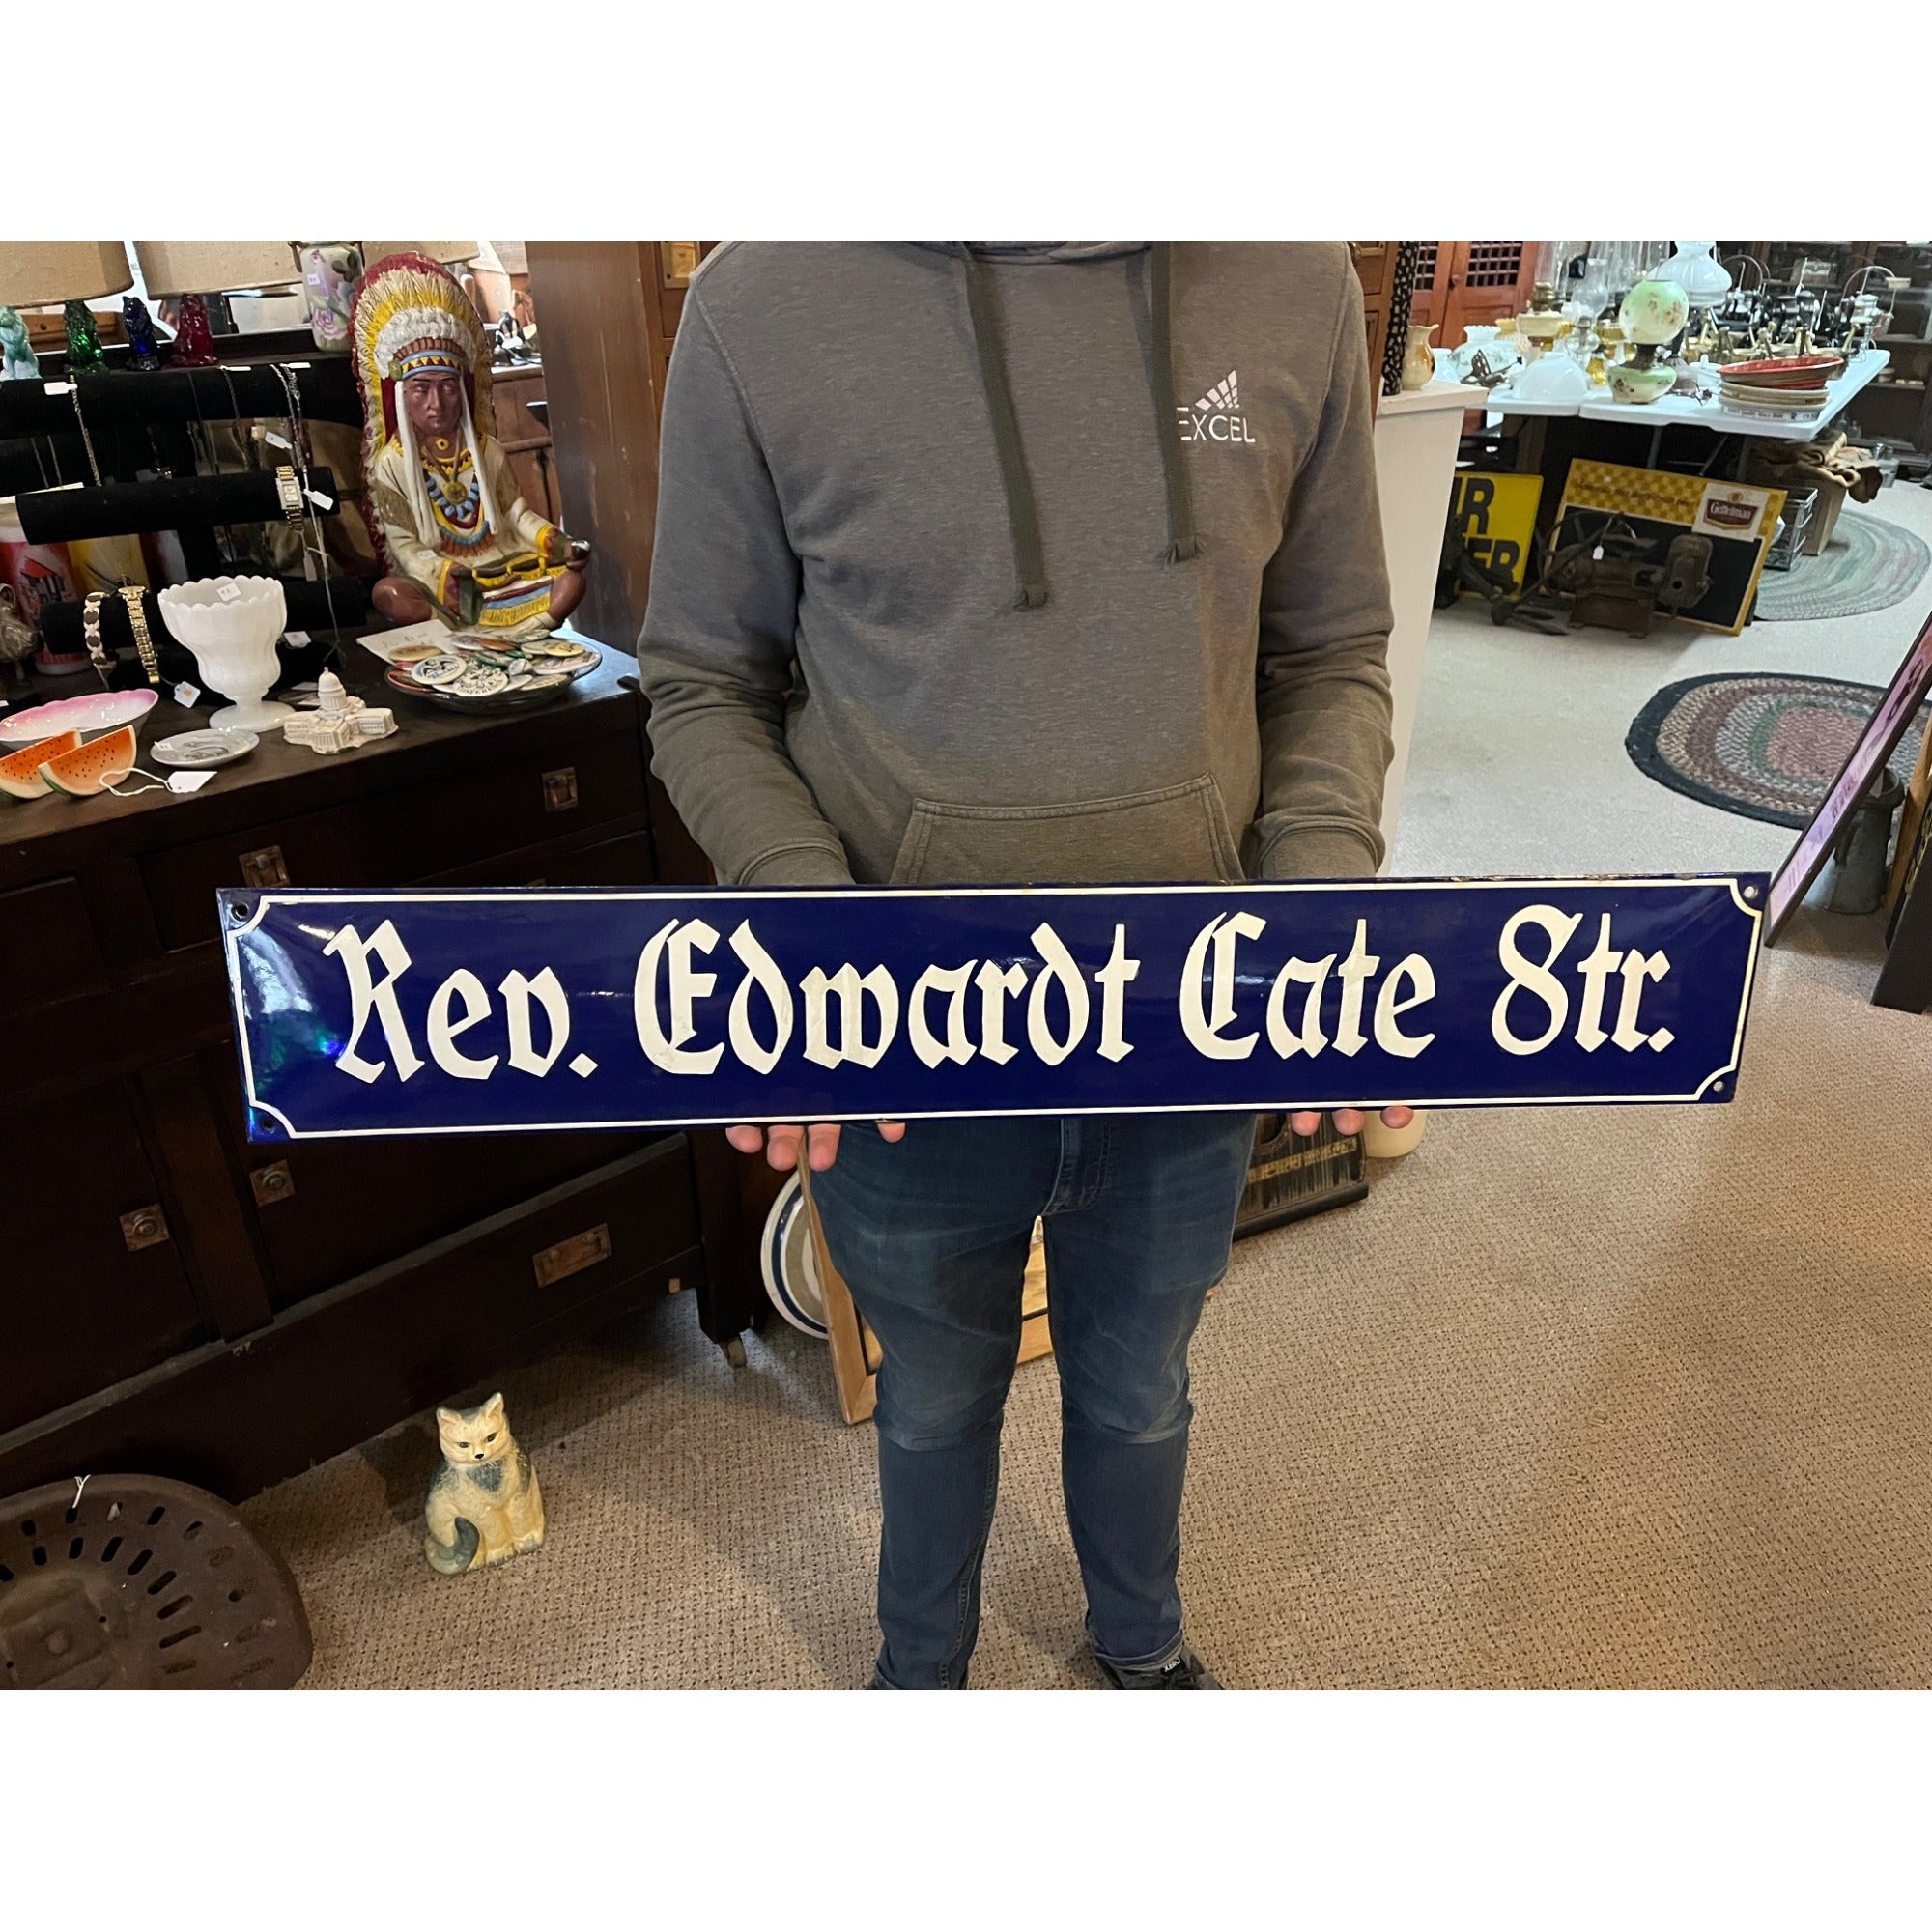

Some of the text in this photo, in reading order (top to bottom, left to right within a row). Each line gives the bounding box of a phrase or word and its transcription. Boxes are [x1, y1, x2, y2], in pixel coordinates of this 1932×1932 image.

[1176, 405, 1256, 444] EXCEL
[322, 904, 1675, 1084] Rev. Edwardt Cate Str.
